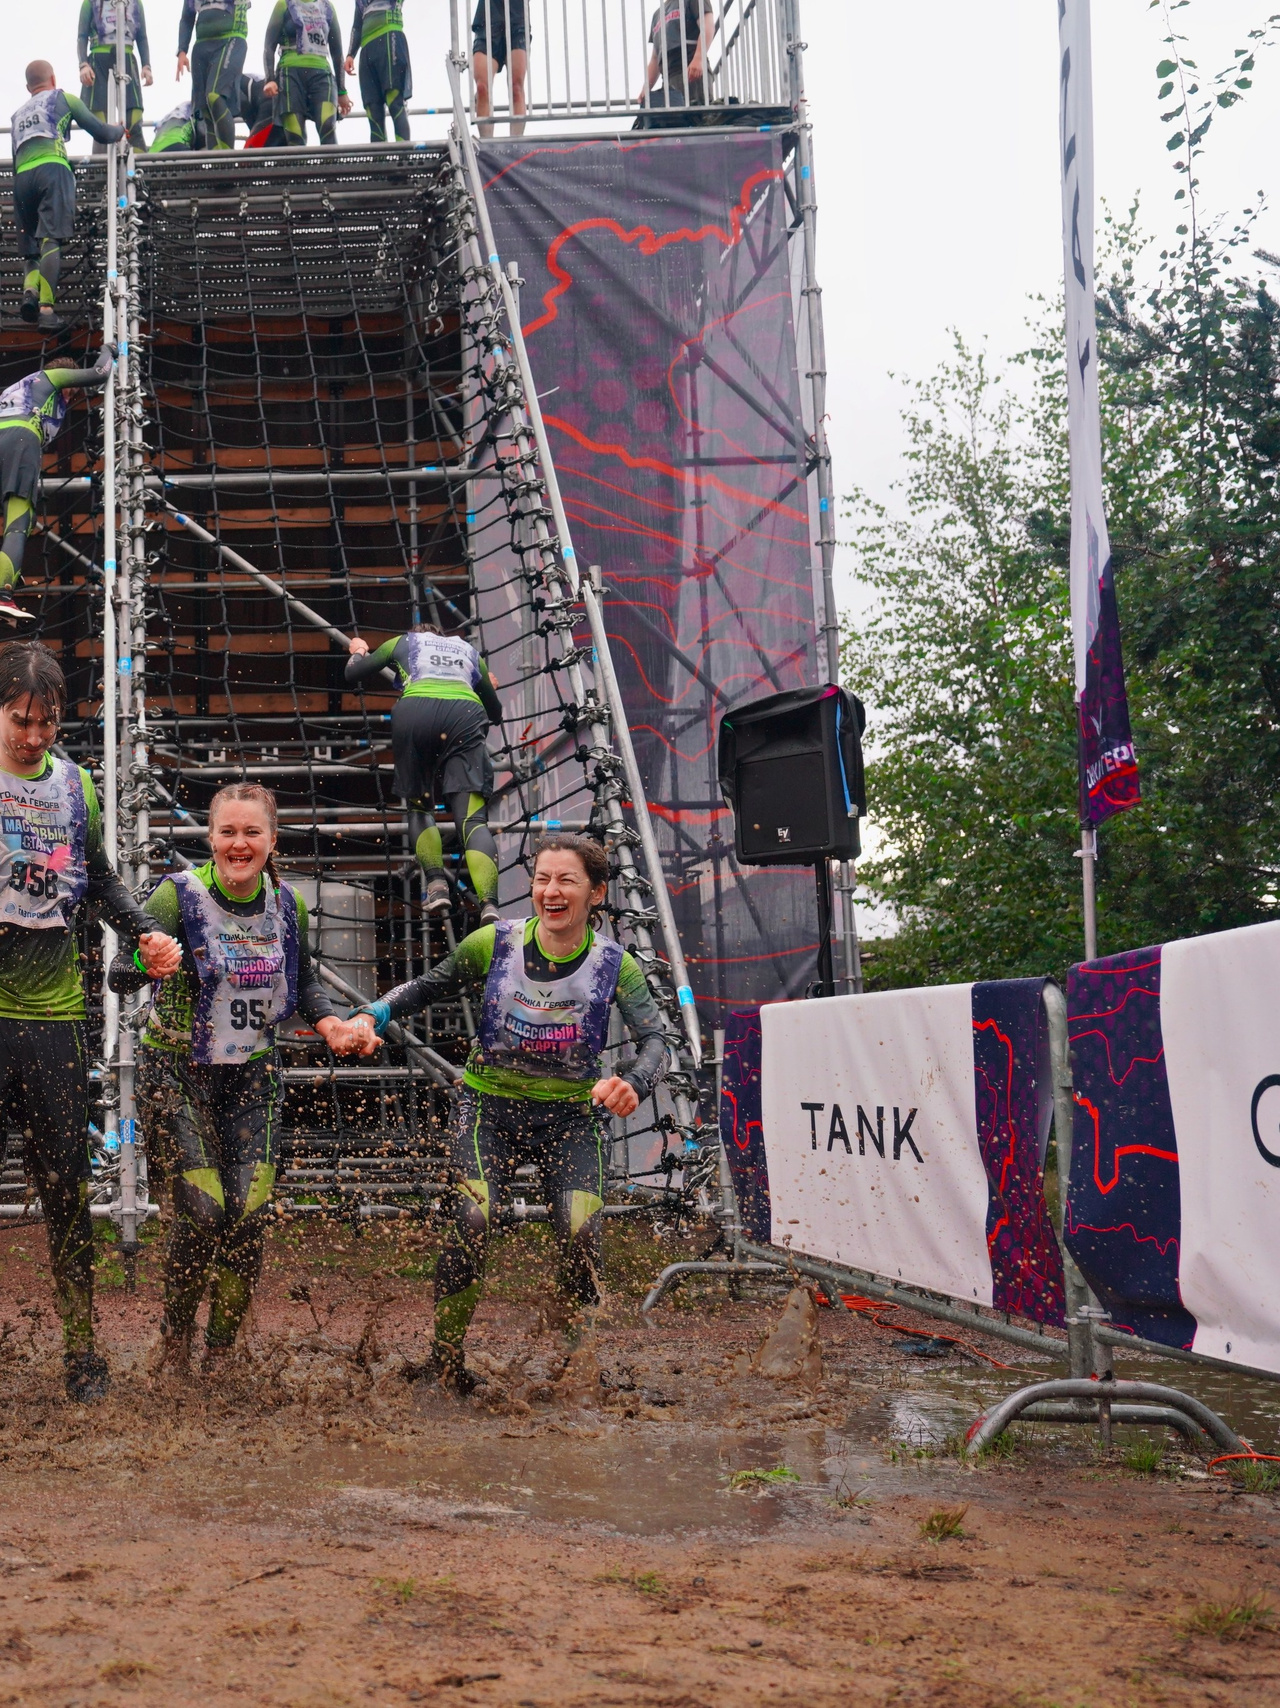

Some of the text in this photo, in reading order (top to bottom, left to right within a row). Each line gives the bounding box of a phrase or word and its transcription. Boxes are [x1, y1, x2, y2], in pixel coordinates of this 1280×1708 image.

[430, 655, 464, 669] 954
[29, 798, 60, 809] ГЕРОЕВ
[513, 990, 577, 1009] ГОНКА ГЕРОЕВ
[506, 1016, 575, 1041] МАССОВЫЙ
[522, 1040, 558, 1053] СТАРТ
[801, 1101, 925, 1164] TANK
